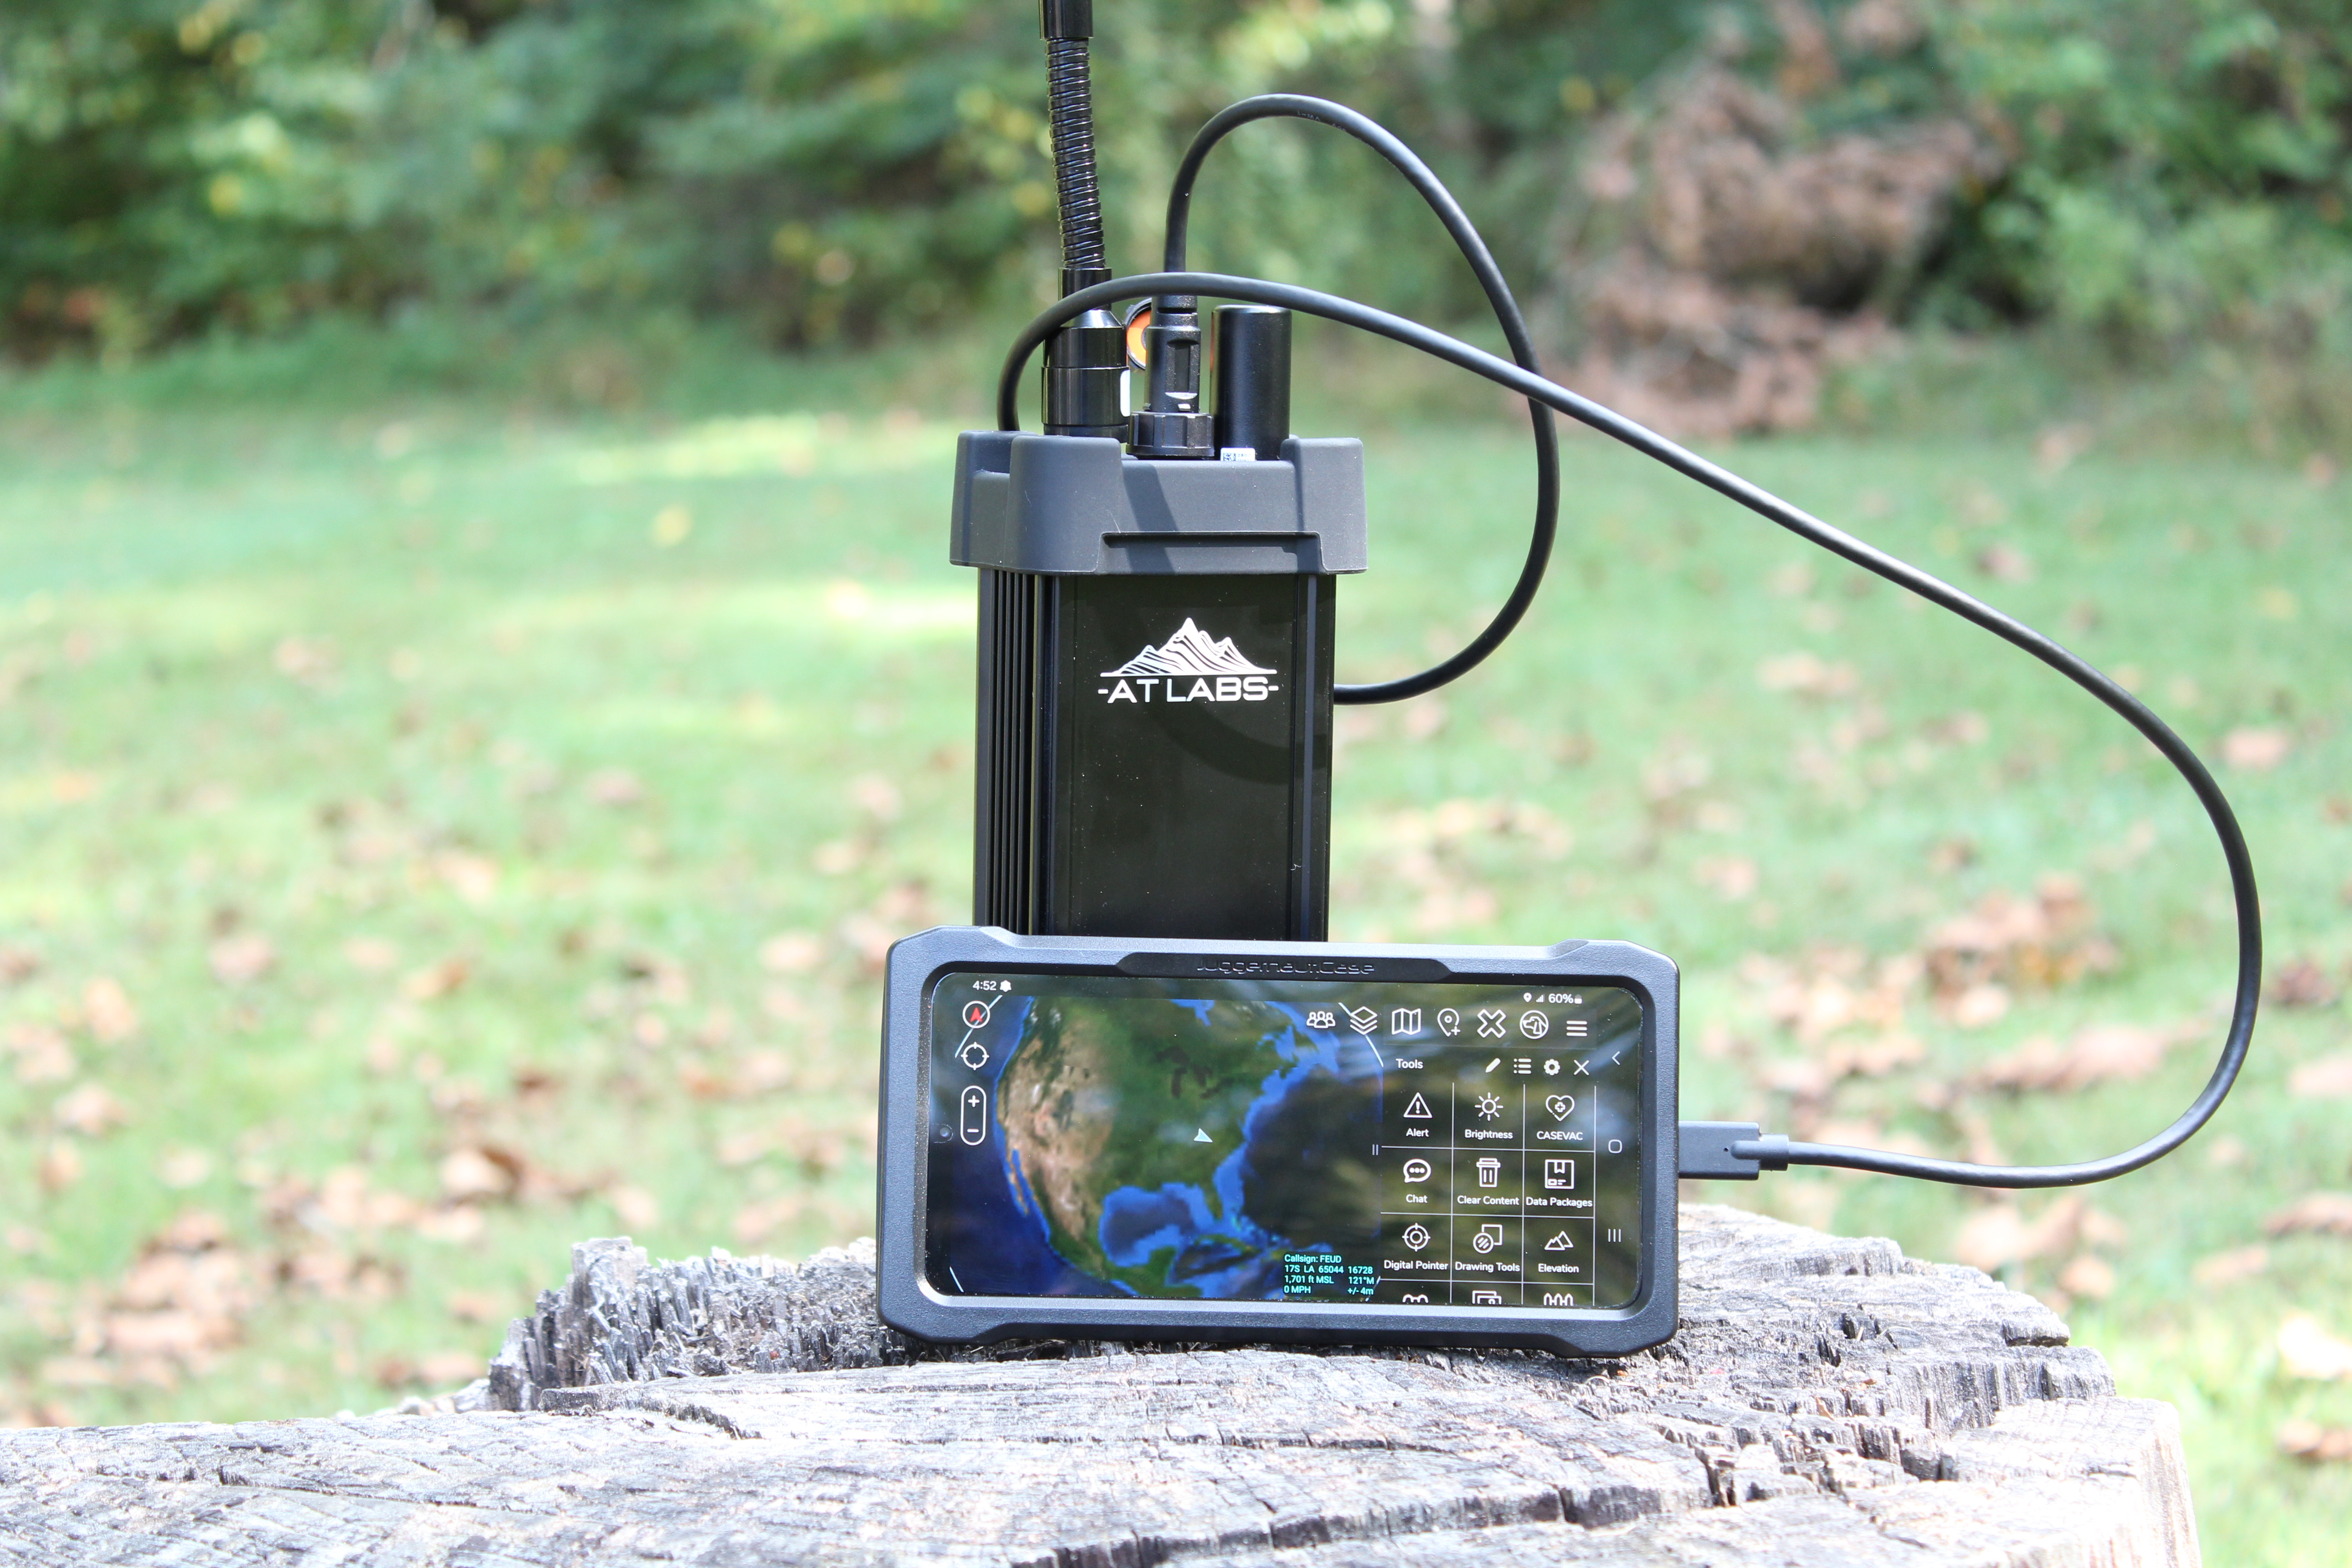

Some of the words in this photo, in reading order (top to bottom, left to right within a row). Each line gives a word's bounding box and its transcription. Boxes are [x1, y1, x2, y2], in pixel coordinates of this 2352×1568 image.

[972, 980, 997, 990] 4:52
[1548, 993, 1574, 1004] 60%
[1396, 1058, 1424, 1069] Tools
[1406, 1128, 1430, 1137] Alert
[1464, 1129, 1514, 1140] Brightness
[1536, 1131, 1583, 1141] CASEVAC
[1406, 1194, 1428, 1204] Chat
[1457, 1195, 1481, 1205] Clear
[1483, 1196, 1519, 1205] Content
[1525, 1197, 1548, 1206] Data
[1550, 1197, 1593, 1209] Packages
[1284, 1254, 1318, 1264] Callsign:
[1320, 1255, 1342, 1263] FEUD
[1284, 1264, 1300, 1273] 17S
[1318, 1265, 1344, 1274] 65044
[1348, 1266, 1373, 1274] 16728
[1384, 1260, 1413, 1271] Digital
[1416, 1260, 1449, 1270] Pointer
[1455, 1261, 1494, 1273] Drawing
[1496, 1262, 1520, 1272] Tools
[1538, 1263, 1580, 1274] Elevation
[1284, 1275, 1306, 1284] 1,701
[1316, 1276, 1334, 1284] MSL
[1348, 1276, 1374, 1284] 121°M
